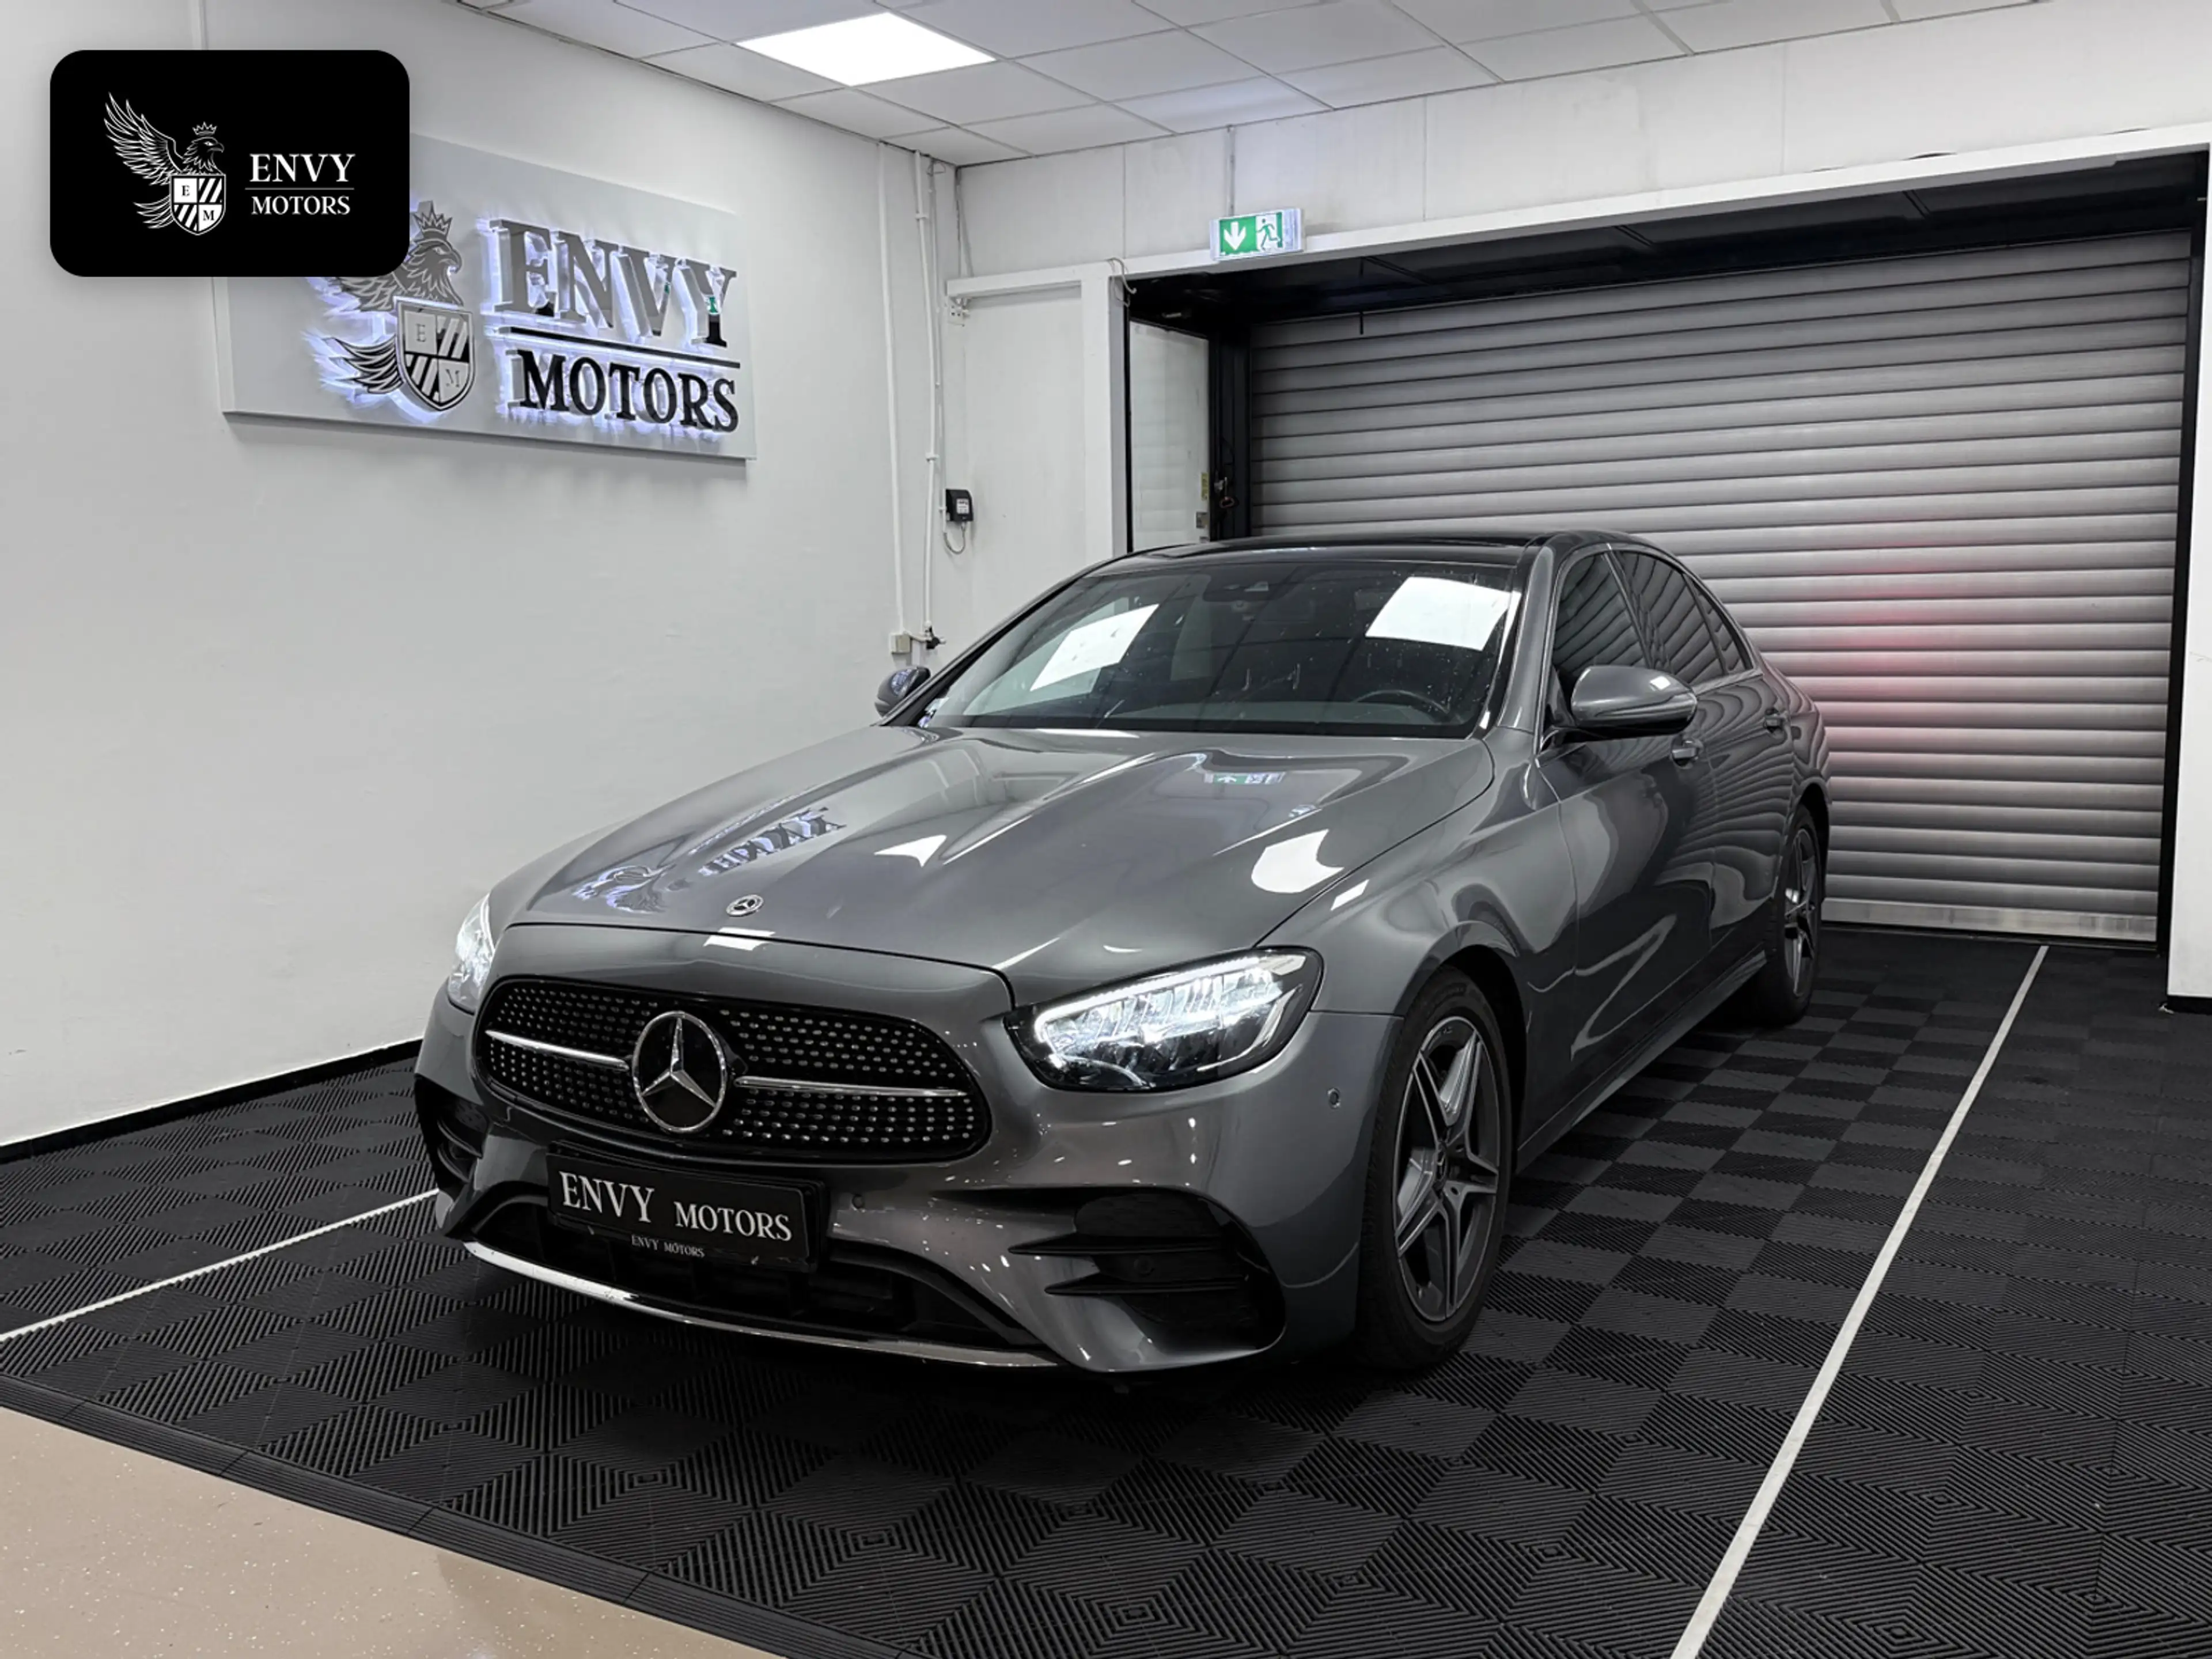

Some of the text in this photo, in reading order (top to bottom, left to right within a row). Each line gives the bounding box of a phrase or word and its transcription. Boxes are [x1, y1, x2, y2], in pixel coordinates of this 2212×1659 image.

[494, 219, 737, 348] ENVY
[506, 349, 739, 433] MOTORS
[559, 1171, 793, 1241] ENVY MOTORS
[631, 1234, 704, 1257] ENVY MOTORS
